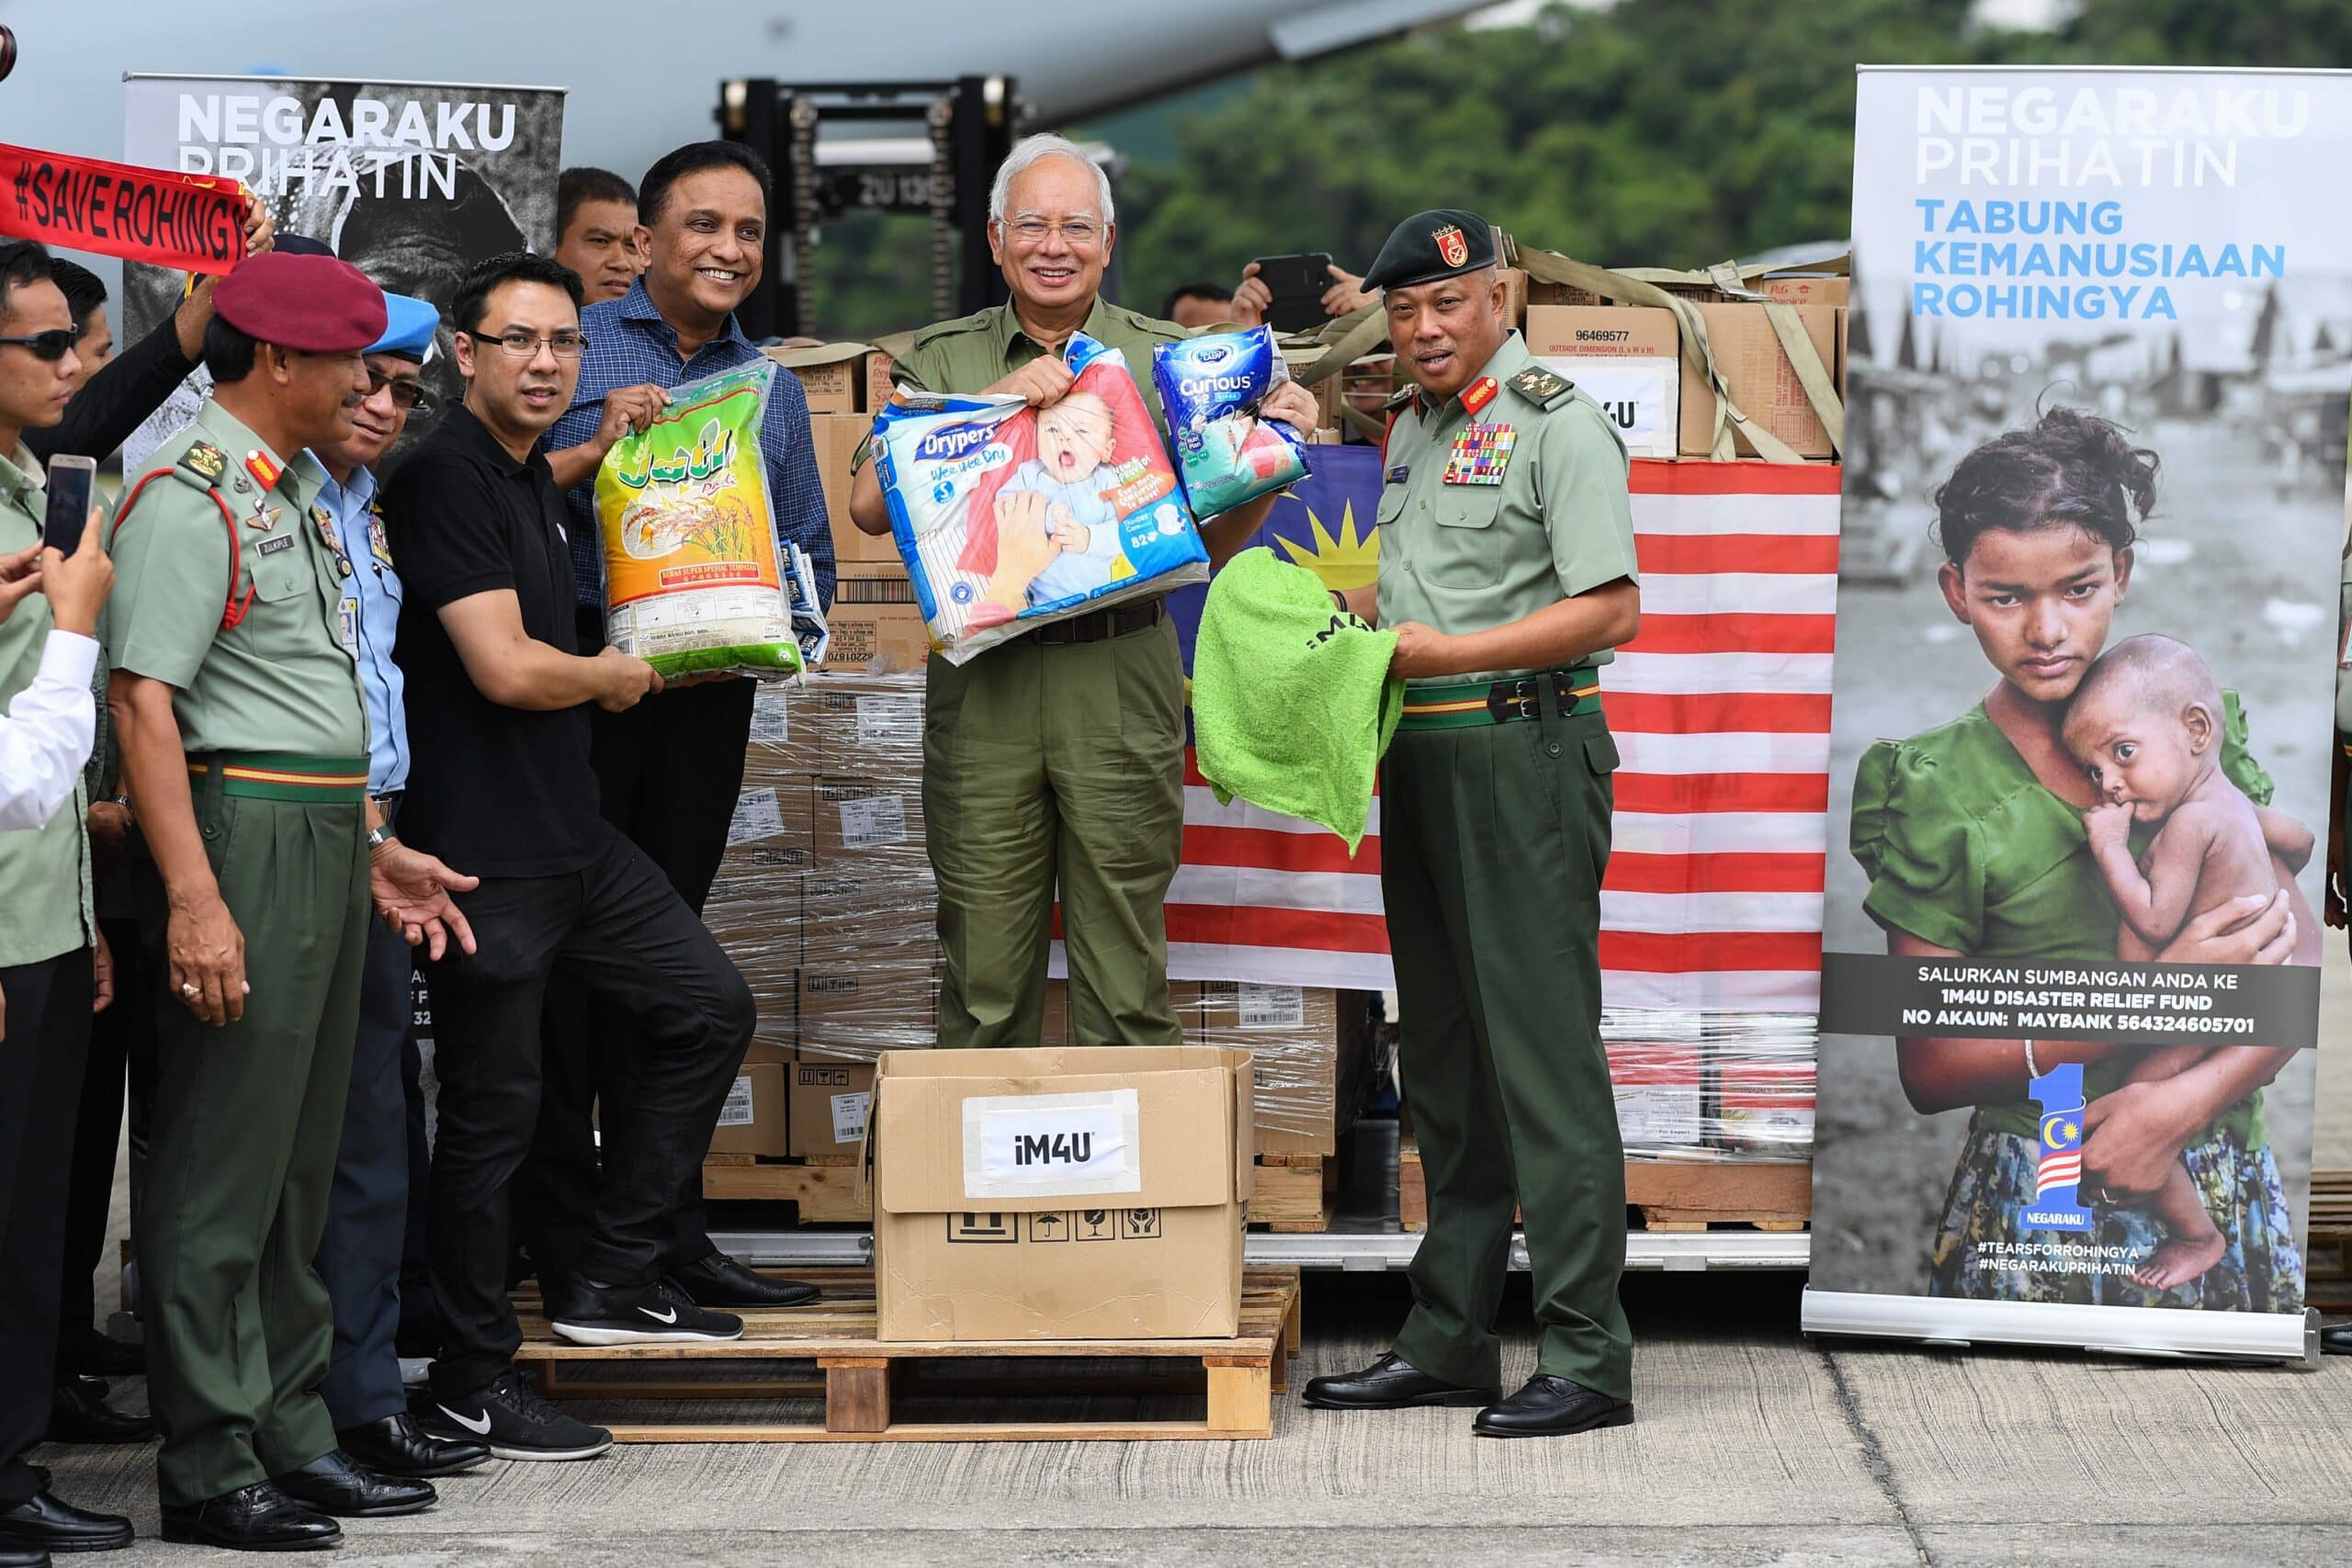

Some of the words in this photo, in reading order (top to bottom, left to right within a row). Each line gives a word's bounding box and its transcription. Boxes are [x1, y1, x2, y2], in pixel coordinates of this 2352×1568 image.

[178, 94, 516, 152] NEGARAKU
[1917, 86, 2309, 138] NEGARAKU
[179, 145, 458, 200] PRIHATIN
[1916, 138, 2238, 187] PRIHATIN
[1915, 198, 2123, 235] TABUNG
[1914, 241, 2286, 278] KEMANUSIAAN
[1913, 282, 2177, 321] ROHINGYA
[1575, 330, 1630, 342] 96469577
[1549, 344, 1577, 353] OUTSIDE
[1578, 345, 1617, 354] DIMENSION
[1180, 373, 1251, 396] Curious
[924, 424, 995, 457] Drypers
[981, 448, 1006, 463] Dry
[1131, 534, 1148, 548] 82
[1917, 966, 2019, 984] SALURKAN
[2024, 969, 2146, 987] SUMBANGAN
[2151, 972, 2208, 989] ANDA
[2213, 974, 2238, 989] KE
[1940, 988, 1989, 1005] 1M4U
[1994, 990, 2086, 1008] DISASTER
[2090, 992, 2155, 1009] RELIEF
[2159, 994, 2213, 1010] FUND
[1902, 1009, 1931, 1025] NO
[1935, 1010, 2008, 1027] AKAUN:
[2017, 1012, 2113, 1030] MAYBANK
[2117, 1014, 2255, 1033] 564324605701
[1014, 1132, 1091, 1166] iM4U
[2026, 1212, 2086, 1226] NEGARAKU
[1977, 1241, 2139, 1259] #TEARSFORROHINGYA
[1979, 1258, 2135, 1276] #NEGARAKUPRIHATIN
